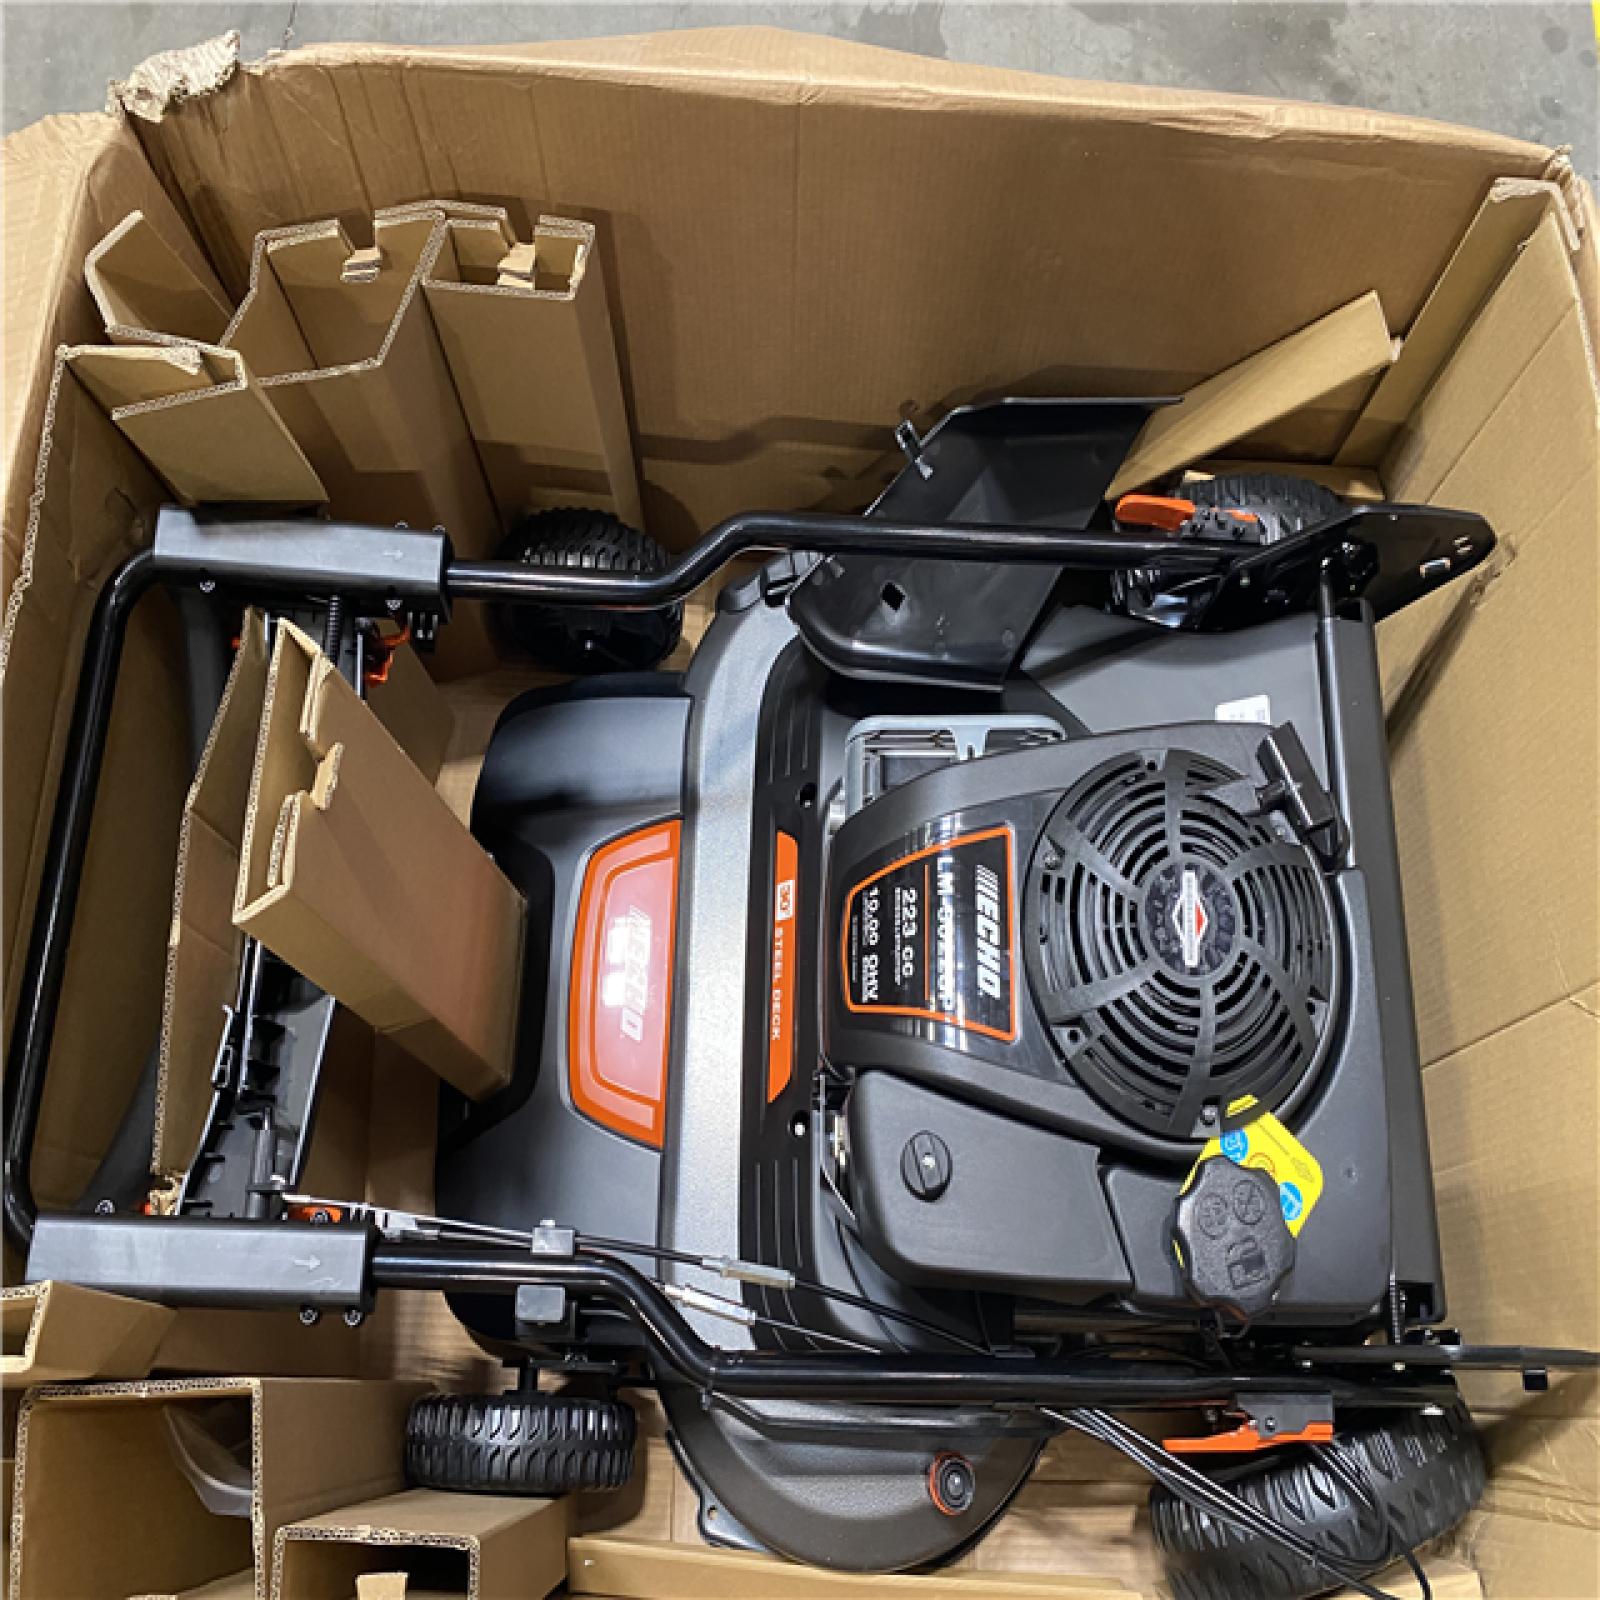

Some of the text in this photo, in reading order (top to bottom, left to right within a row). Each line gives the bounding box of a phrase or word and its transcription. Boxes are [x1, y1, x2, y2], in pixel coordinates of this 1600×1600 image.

[902, 887, 918, 936] 223
[774, 927, 784, 982] STEEL
[976, 890, 1001, 1000] ECHO
[772, 989, 782, 1041] DECK
